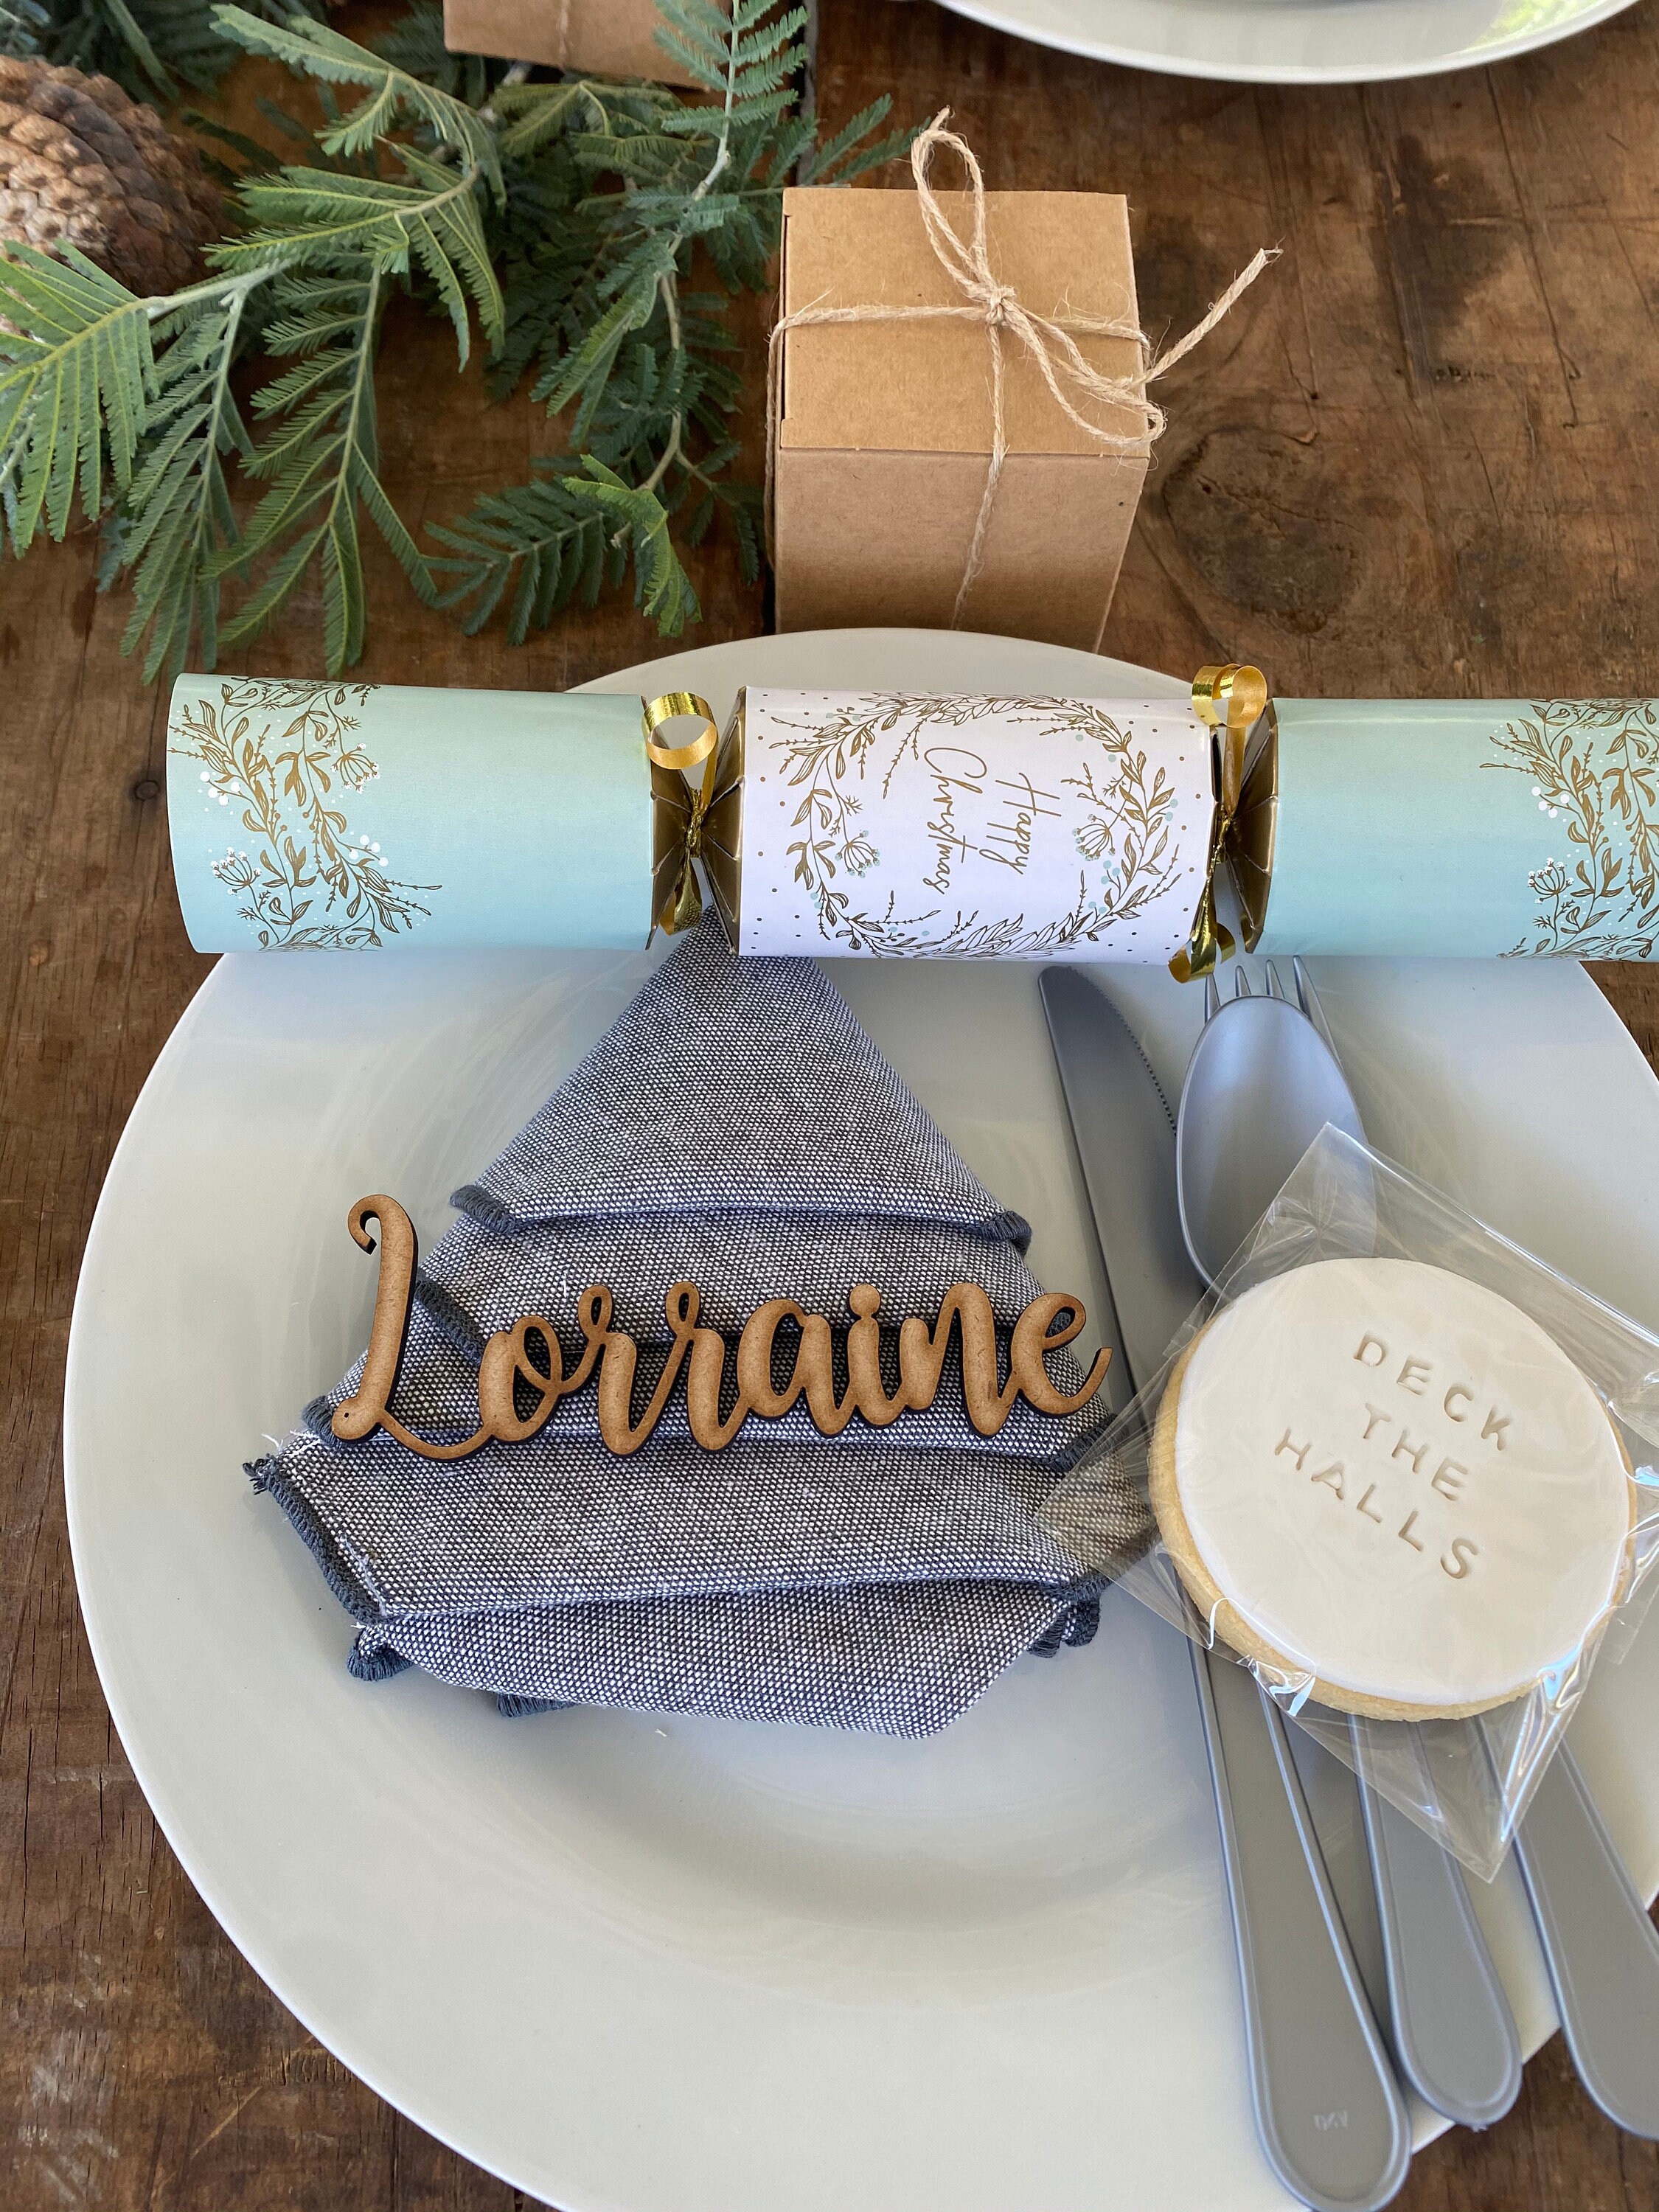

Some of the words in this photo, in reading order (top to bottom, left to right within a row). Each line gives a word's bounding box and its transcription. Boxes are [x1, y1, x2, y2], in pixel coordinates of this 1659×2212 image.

[922, 747, 987, 894] Christmas
[978, 772, 1062, 875] Happy
[331, 1193, 1113, 1464] Lorraine
[1353, 1332, 1512, 1451] DECK
[1274, 1427, 1478, 1579] HALLS
[1364, 1402, 1470, 1501] THE
